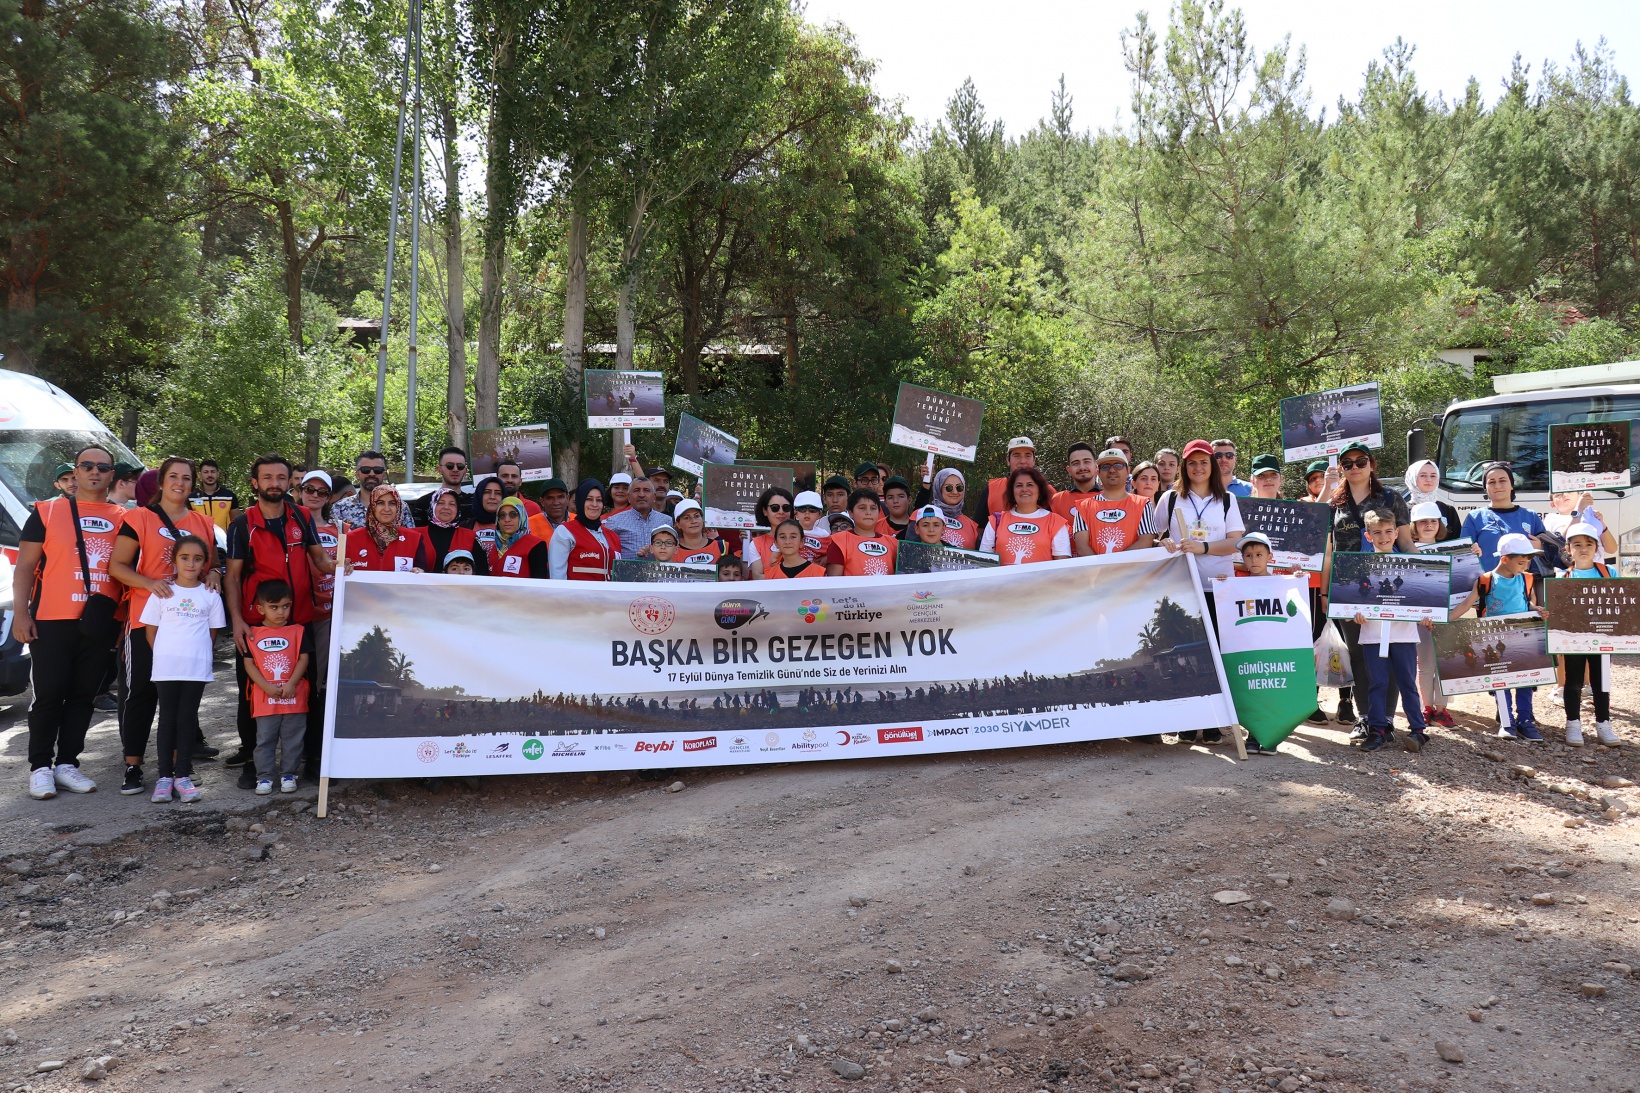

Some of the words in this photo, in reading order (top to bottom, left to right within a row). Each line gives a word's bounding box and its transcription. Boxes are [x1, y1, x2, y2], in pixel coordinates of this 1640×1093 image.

[926, 395, 956, 408] DÜNYA
[917, 402, 962, 418] TEMİZLİK
[926, 413, 950, 424] GÜNÜ
[1575, 429, 1604, 438] DÜNYA
[1568, 439, 1612, 448] TEMİZLİK
[1578, 447, 1601, 456] GÜNÜ
[733, 472, 764, 480] DÜNYA
[724, 481, 772, 489] TEMİZLİK
[736, 490, 760, 498] GÜNÜ
[1258, 504, 1295, 514] DÜNYA
[83, 519, 103, 527] TEMA
[1247, 514, 1304, 525] TEMİZLİK
[1259, 524, 1289, 533] GÜNÜ
[864, 543, 881, 551] TEMA
[1582, 585, 1624, 594] DÜNYA
[1572, 596, 1636, 605] TEMİZLİK
[906, 603, 944, 611] GÜMÜŞHANE
[1235, 598, 1283, 617] TEMA
[1588, 606, 1620, 615] GÜNÜ
[720, 615, 737, 624] GÜNÜ
[835, 610, 882, 622] Türkiye
[909, 616, 941, 624] MERKEZLERİ
[1476, 619, 1506, 628] DÜNYA
[1469, 625, 1515, 636] TEMİZLİK
[611, 638, 704, 673] BAŞKA
[712, 630, 760, 665] BİR
[768, 631, 892, 663] GEZEGEN
[900, 628, 957, 656] YOK
[1238, 661, 1296, 676] GÜMÜŞHANE
[668, 673, 677, 682] 17
[679, 671, 702, 684] Eylül
[705, 671, 734, 683] Dünya
[737, 669, 775, 681] Temizlik
[777, 667, 821, 680] Günü'nde
[823, 666, 837, 677] Siz
[840, 667, 851, 676] de
[853, 664, 887, 676] Yerinizi
[890, 664, 907, 674] Alın
[1247, 677, 1287, 690] MERKEZ
[933, 726, 970, 736] IMPACT
[974, 724, 1000, 733] 2030
[634, 740, 675, 754] Beybi
[684, 738, 716, 750] KOROPLAST
[791, 741, 829, 750] Abilitypool
